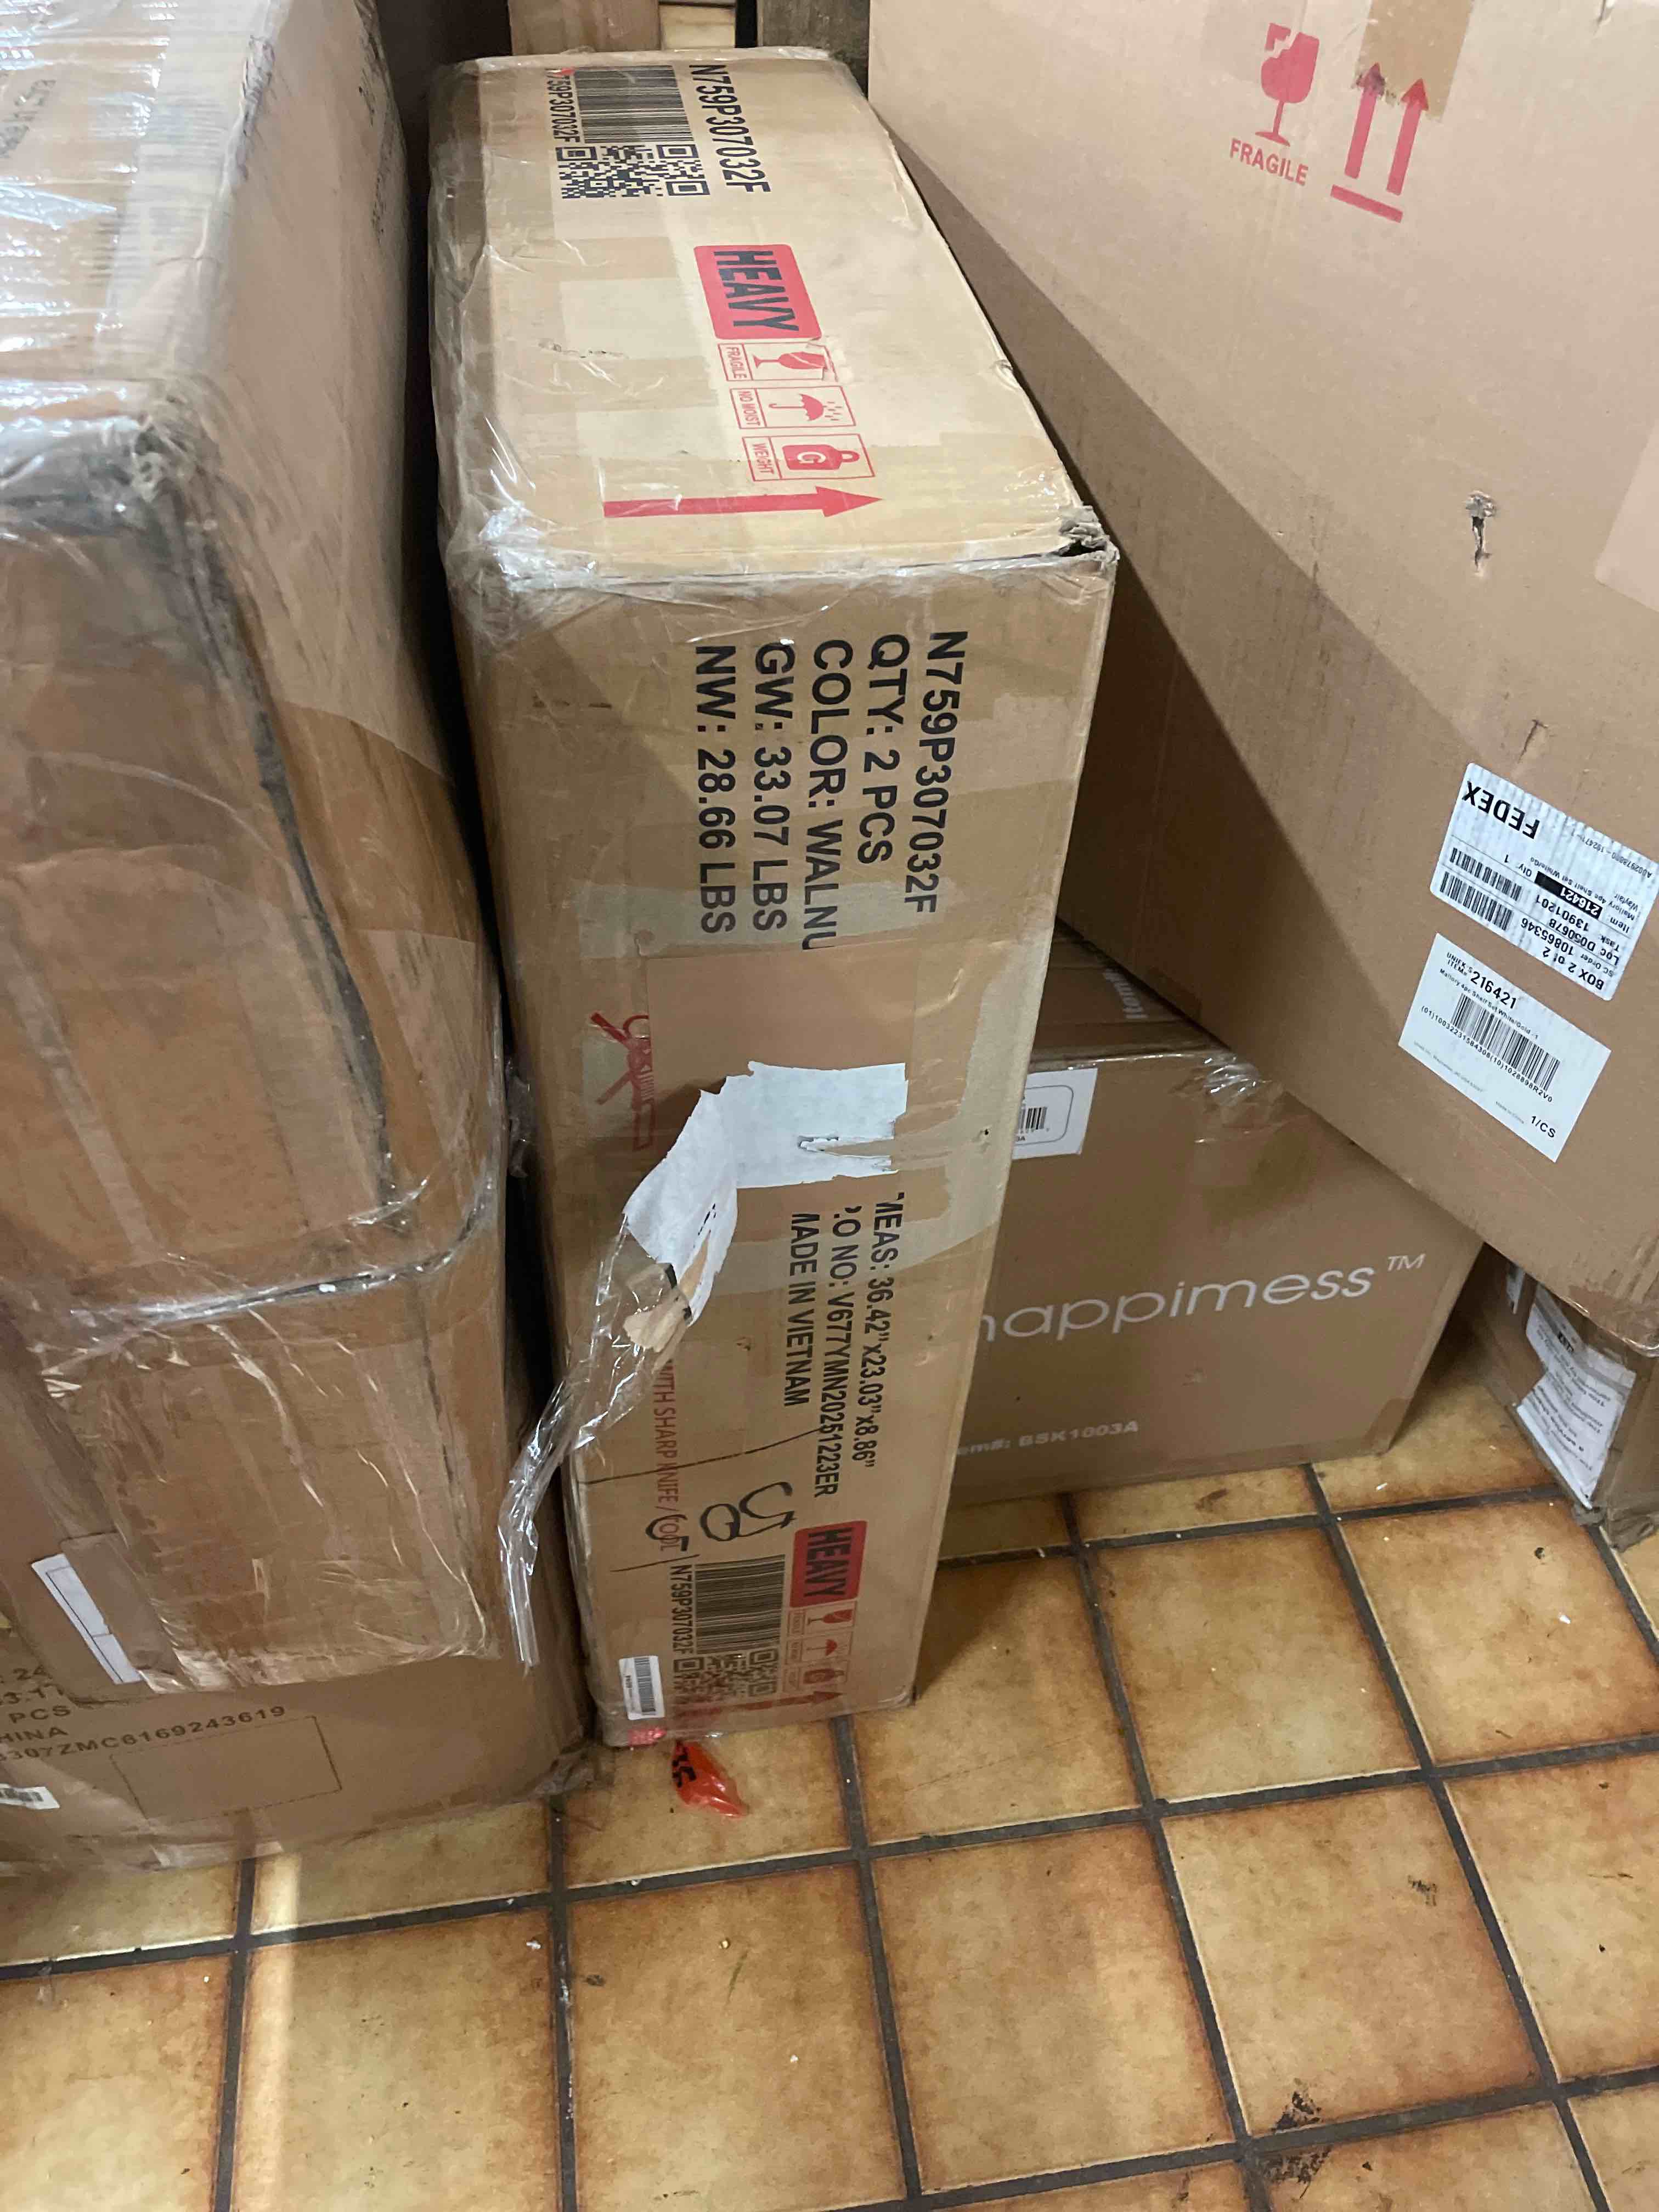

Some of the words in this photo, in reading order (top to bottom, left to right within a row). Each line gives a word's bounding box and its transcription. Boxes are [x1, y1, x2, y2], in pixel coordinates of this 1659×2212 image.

[545, 69, 580, 143] 759P307032F
[689, 65, 771, 192] N759P307032F
[1230, 138, 1308, 186] FRAGILE
[714, 250, 799, 331] HEAVY
[725, 346, 748, 380] FRAGILE
[738, 391, 752, 402] NO
[742, 404, 760, 427] MOIST
[752, 443, 774, 475] WEIGHT
[695, 645, 736, 732] NW:
[754, 644, 795, 731] GW:
[867, 634, 910, 735] QTY:
[808, 639, 854, 809] COLOR:
[864, 749, 900, 773] 2
[904, 631, 969, 913] N759P307032F
[697, 749, 736, 849] 28.66
[753, 746, 792, 846] 33.07
[1462, 781, 1541, 839] FEDEX
[857, 785, 898, 865] PCS
[1504, 854, 1509, 863] 1
[699, 862, 736, 933] LBS
[752, 860, 788, 932] LBS
[1560, 887, 1598, 916] 216421
[1574, 882, 1592, 896] Shelf
[1613, 893, 1639, 912] Wayfair
[1536, 894, 1589, 932] 13901201
[1607, 901, 1635, 921] Mallory
[1520, 917, 1574, 956] 10865346
[1542, 946, 1551, 957] 2
[1549, 918, 1596, 952] D05067B
[1553, 952, 1566, 964] of
[1567, 962, 1577, 973] 2
[1581, 953, 1602, 969] Order
[1600, 948, 1620, 966] Loc
[1440, 968, 1460, 986] Mallory
[1472, 990, 1487, 1005] Shelf
[1470, 970, 1516, 1009] 216421
[1578, 968, 1605, 990] BOX
[1531, 1115, 1555, 1138] 1/CS
[828, 1244, 859, 1288] NO:
[788, 1281, 816, 1305] IN
[783, 1308, 815, 1407] VIETNAM
[654, 1408, 678, 1458] SHARP
[1019, 1420, 1139, 1447] BSK1003A
[656, 1463, 679, 1503] KNIFE
[804, 1527, 854, 1598] HEAVY
[670, 1564, 694, 1656] N759P307032F
[9, 1705, 72, 1724] PCS
